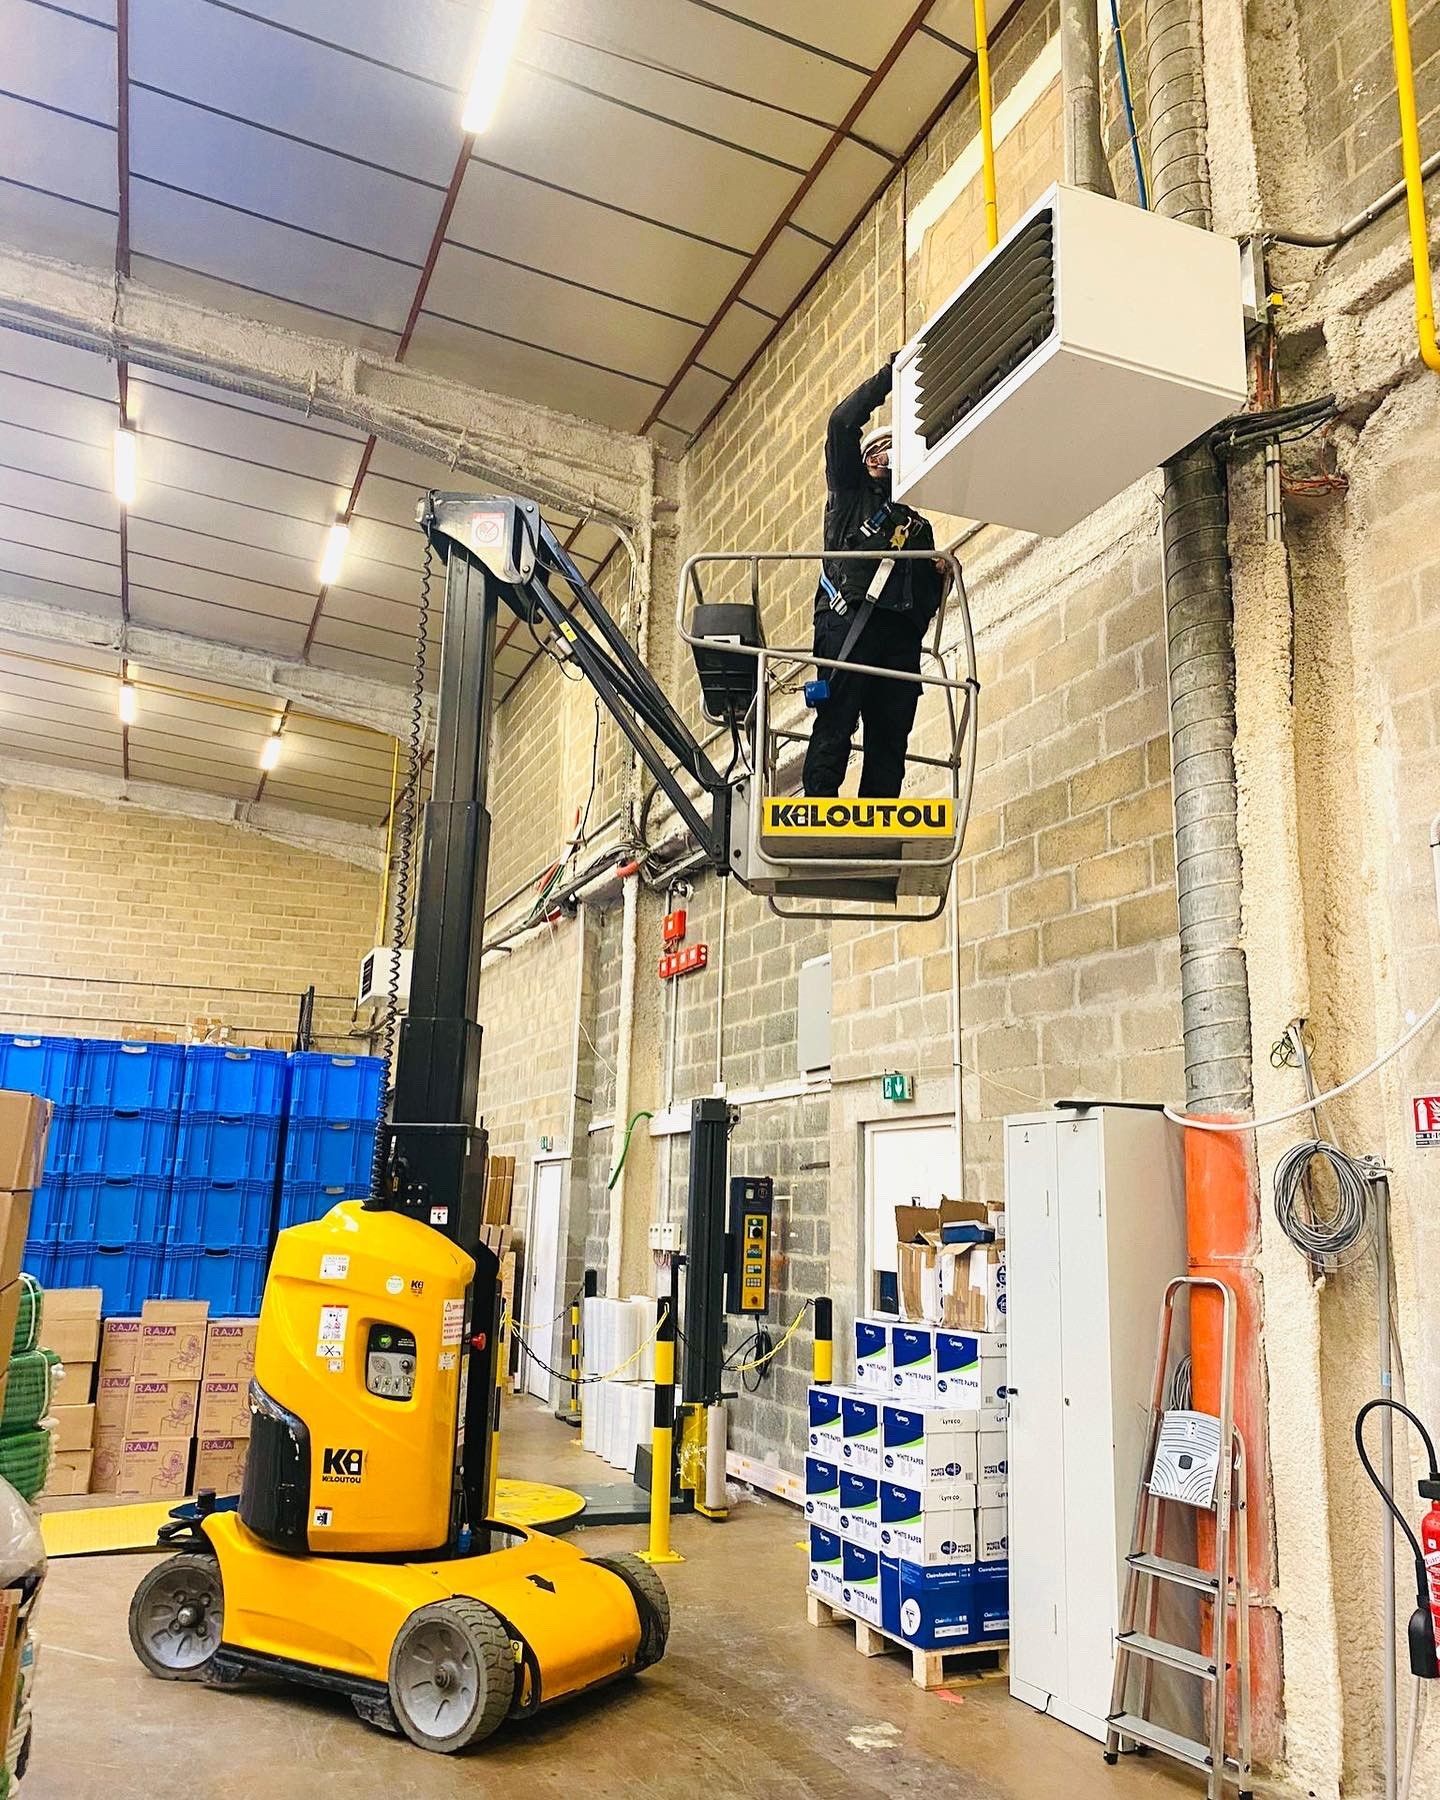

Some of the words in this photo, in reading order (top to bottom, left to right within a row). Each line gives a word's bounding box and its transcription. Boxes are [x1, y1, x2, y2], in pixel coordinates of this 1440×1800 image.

[1072, 1123, 1078, 1132] 2
[1024, 1131, 1029, 1143] 1
[108, 1323, 139, 1332] RAJA
[144, 1327, 175, 1335] RAJA
[212, 1328, 242, 1336] RAJA
[135, 1384, 167, 1392] RAJA
[206, 1383, 237, 1392] RAJA
[964, 1380, 978, 1388] PAPER
[126, 1442, 157, 1451] RAJA
[202, 1441, 233, 1449] RAJA
